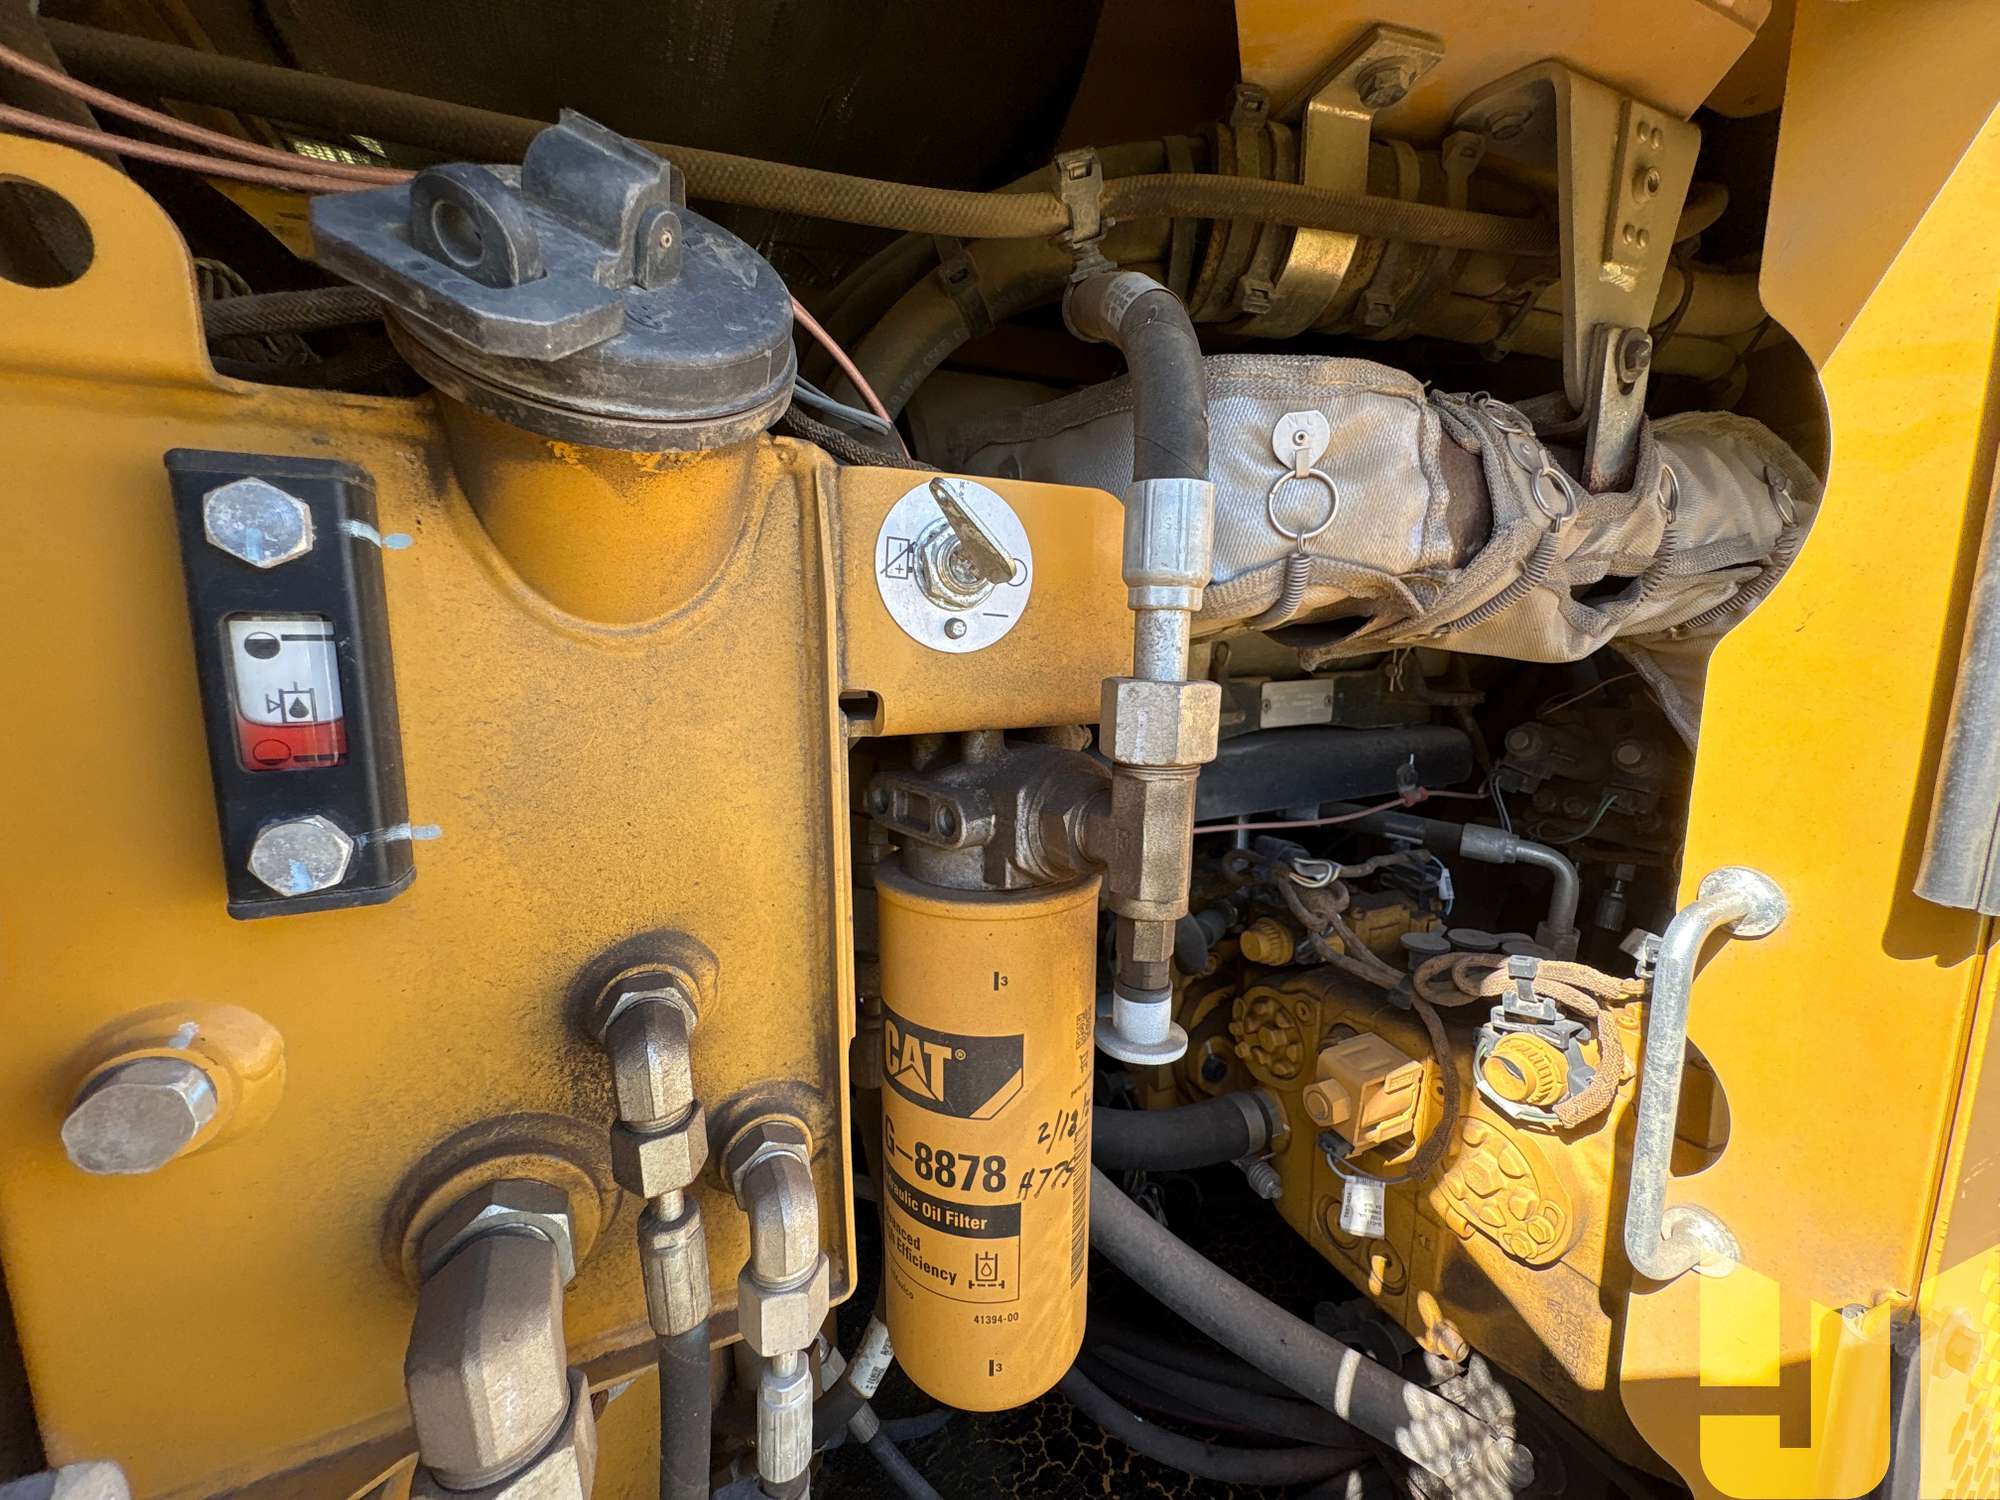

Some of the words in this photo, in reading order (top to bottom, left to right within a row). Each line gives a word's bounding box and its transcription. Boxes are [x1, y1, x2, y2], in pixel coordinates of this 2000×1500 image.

[885, 1114, 1007, 1193] G-8878
[890, 1182, 919, 1211] aulic
[922, 1202, 941, 1222] Oil
[945, 1213, 988, 1230] Filter
[889, 1215, 921, 1250] anced
[896, 1239, 957, 1286] Efficiency
[974, 1312, 1019, 1324] 41394-00
